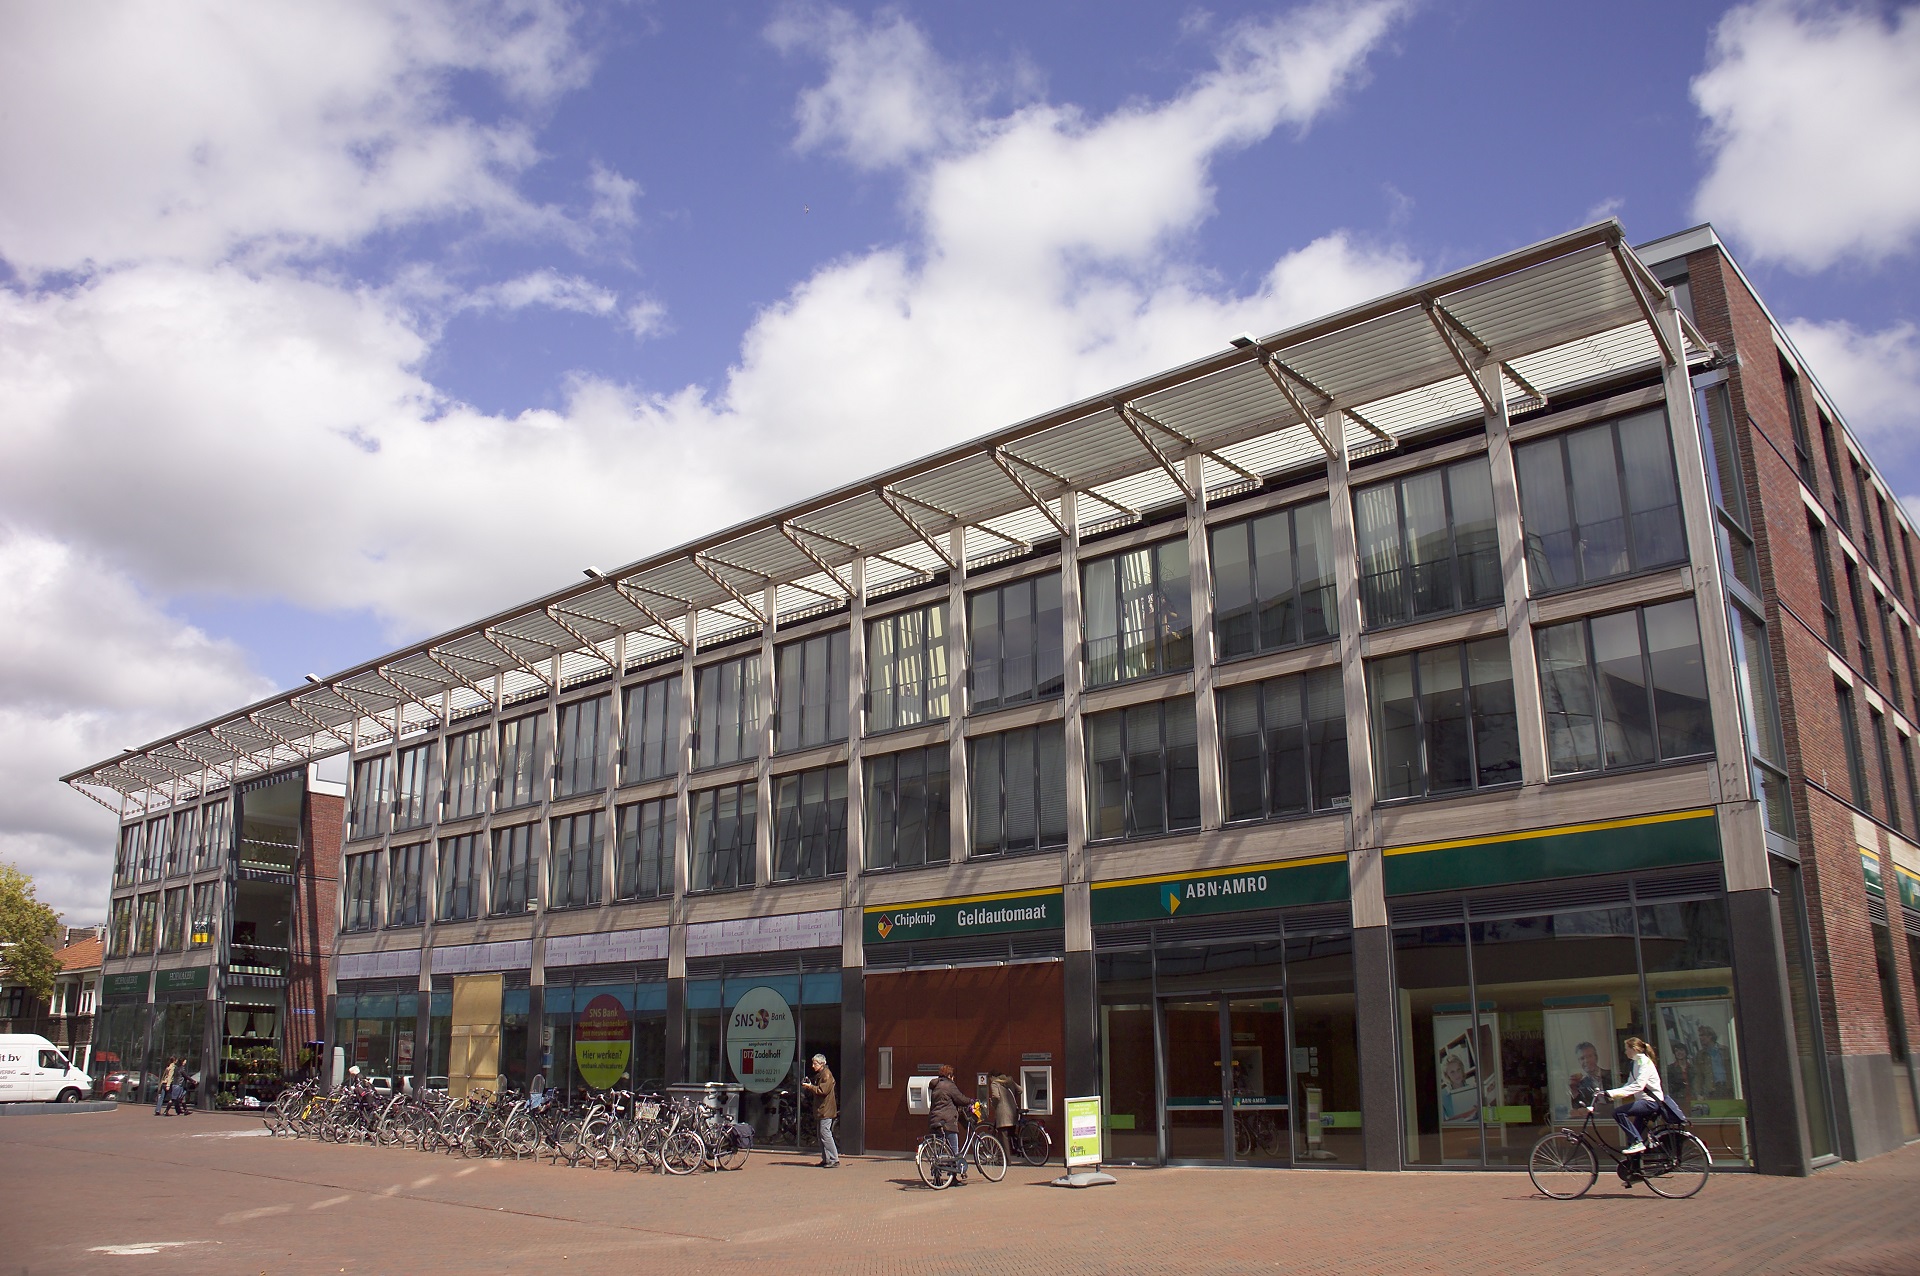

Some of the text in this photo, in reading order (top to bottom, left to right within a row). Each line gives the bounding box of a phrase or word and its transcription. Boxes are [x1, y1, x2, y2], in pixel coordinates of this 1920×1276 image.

[894, 903, 1047, 927] Chipknip Geldautomaat
[589, 1008, 618, 1018] SNS Bank
[735, 1012, 786, 1027] SNS Bank
[8, 1054, 21, 1062] bv
[582, 1050, 622, 1059] Hier werken?
[743, 1049, 781, 1059] DTZ Zadelhoff
